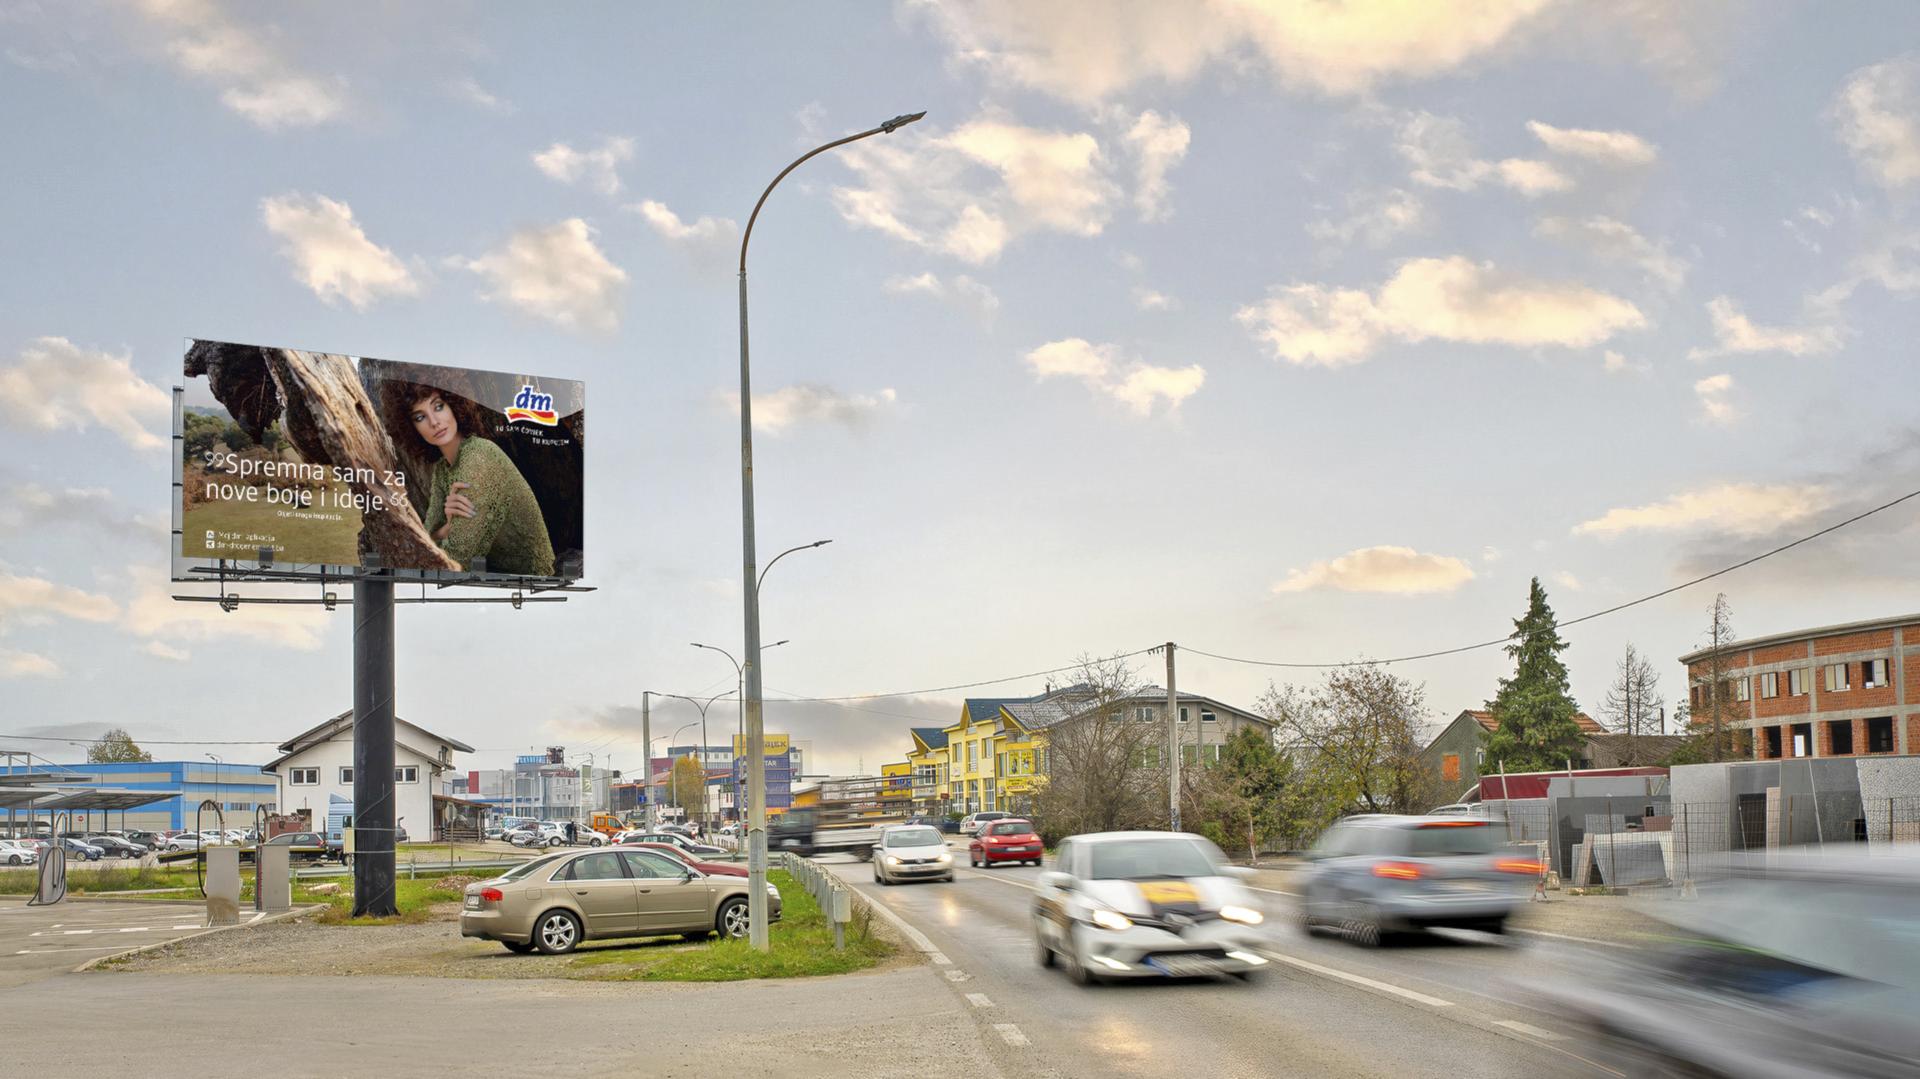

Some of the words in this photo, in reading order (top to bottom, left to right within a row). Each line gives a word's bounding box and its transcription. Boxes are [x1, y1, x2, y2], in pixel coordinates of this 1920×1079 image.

[515, 387, 551, 411] dm
[332, 465, 375, 484] sam
[383, 470, 406, 487] za
[206, 482, 258, 502] nove
[267, 482, 313, 510] boje
[320, 487, 325, 507] i
